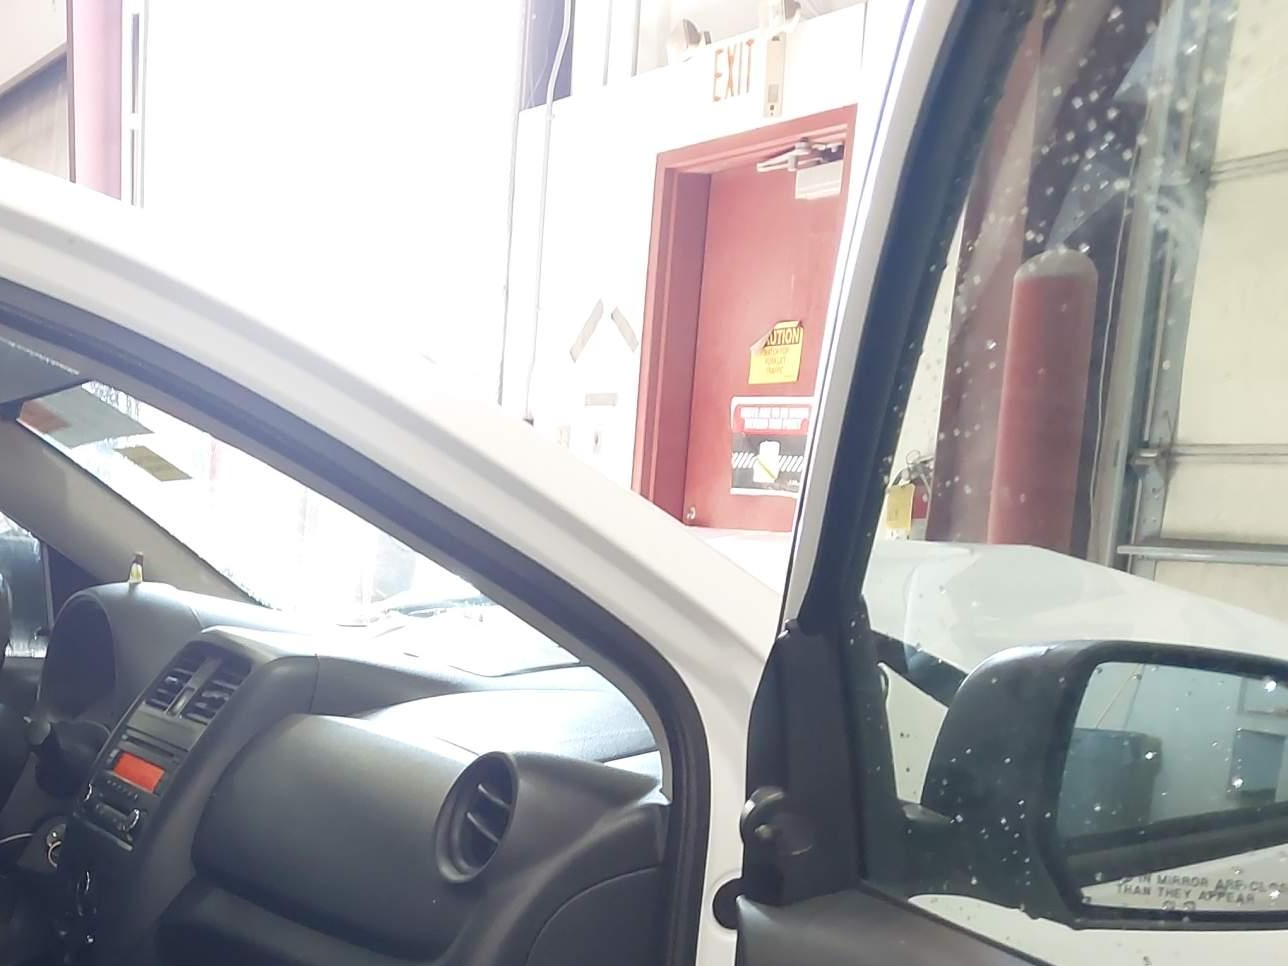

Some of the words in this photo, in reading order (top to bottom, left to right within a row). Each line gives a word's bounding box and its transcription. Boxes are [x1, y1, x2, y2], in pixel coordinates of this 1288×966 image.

[712, 38, 754, 103] EXIT
[1156, 874, 1209, 888] MIRROR
[1117, 884, 1151, 896] THAN
[1158, 887, 1192, 899] THEY
[1198, 890, 1256, 905] APPEAR
